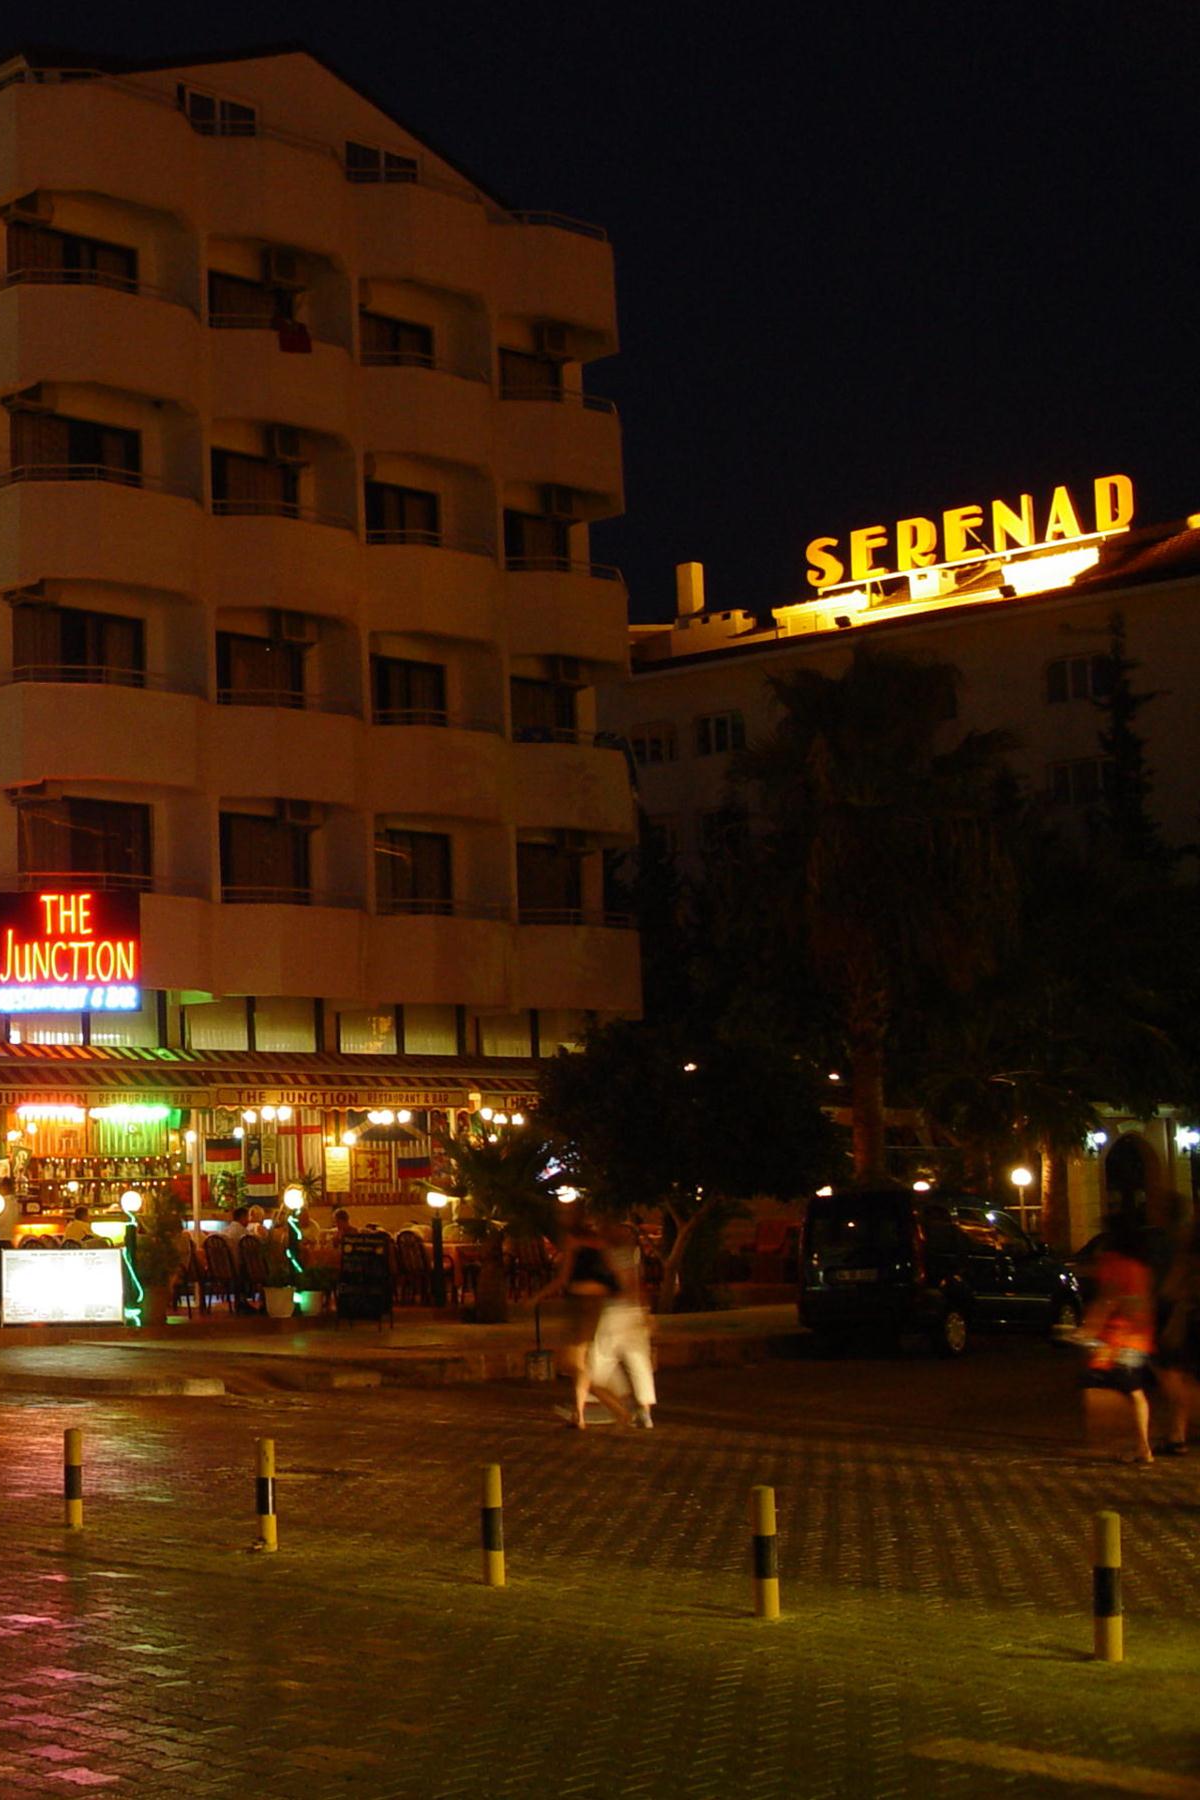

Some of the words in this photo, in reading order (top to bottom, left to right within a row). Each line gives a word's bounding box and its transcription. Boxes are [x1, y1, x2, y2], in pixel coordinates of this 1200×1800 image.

[805, 474, 1134, 587] SERENAD
[40, 893, 93, 935] THE
[237, 1090, 266, 1103] THE
[277, 1091, 359, 1105] JUNCTION
[367, 1092, 420, 1105] RESTAURANT
[431, 1093, 449, 1105] BAR
